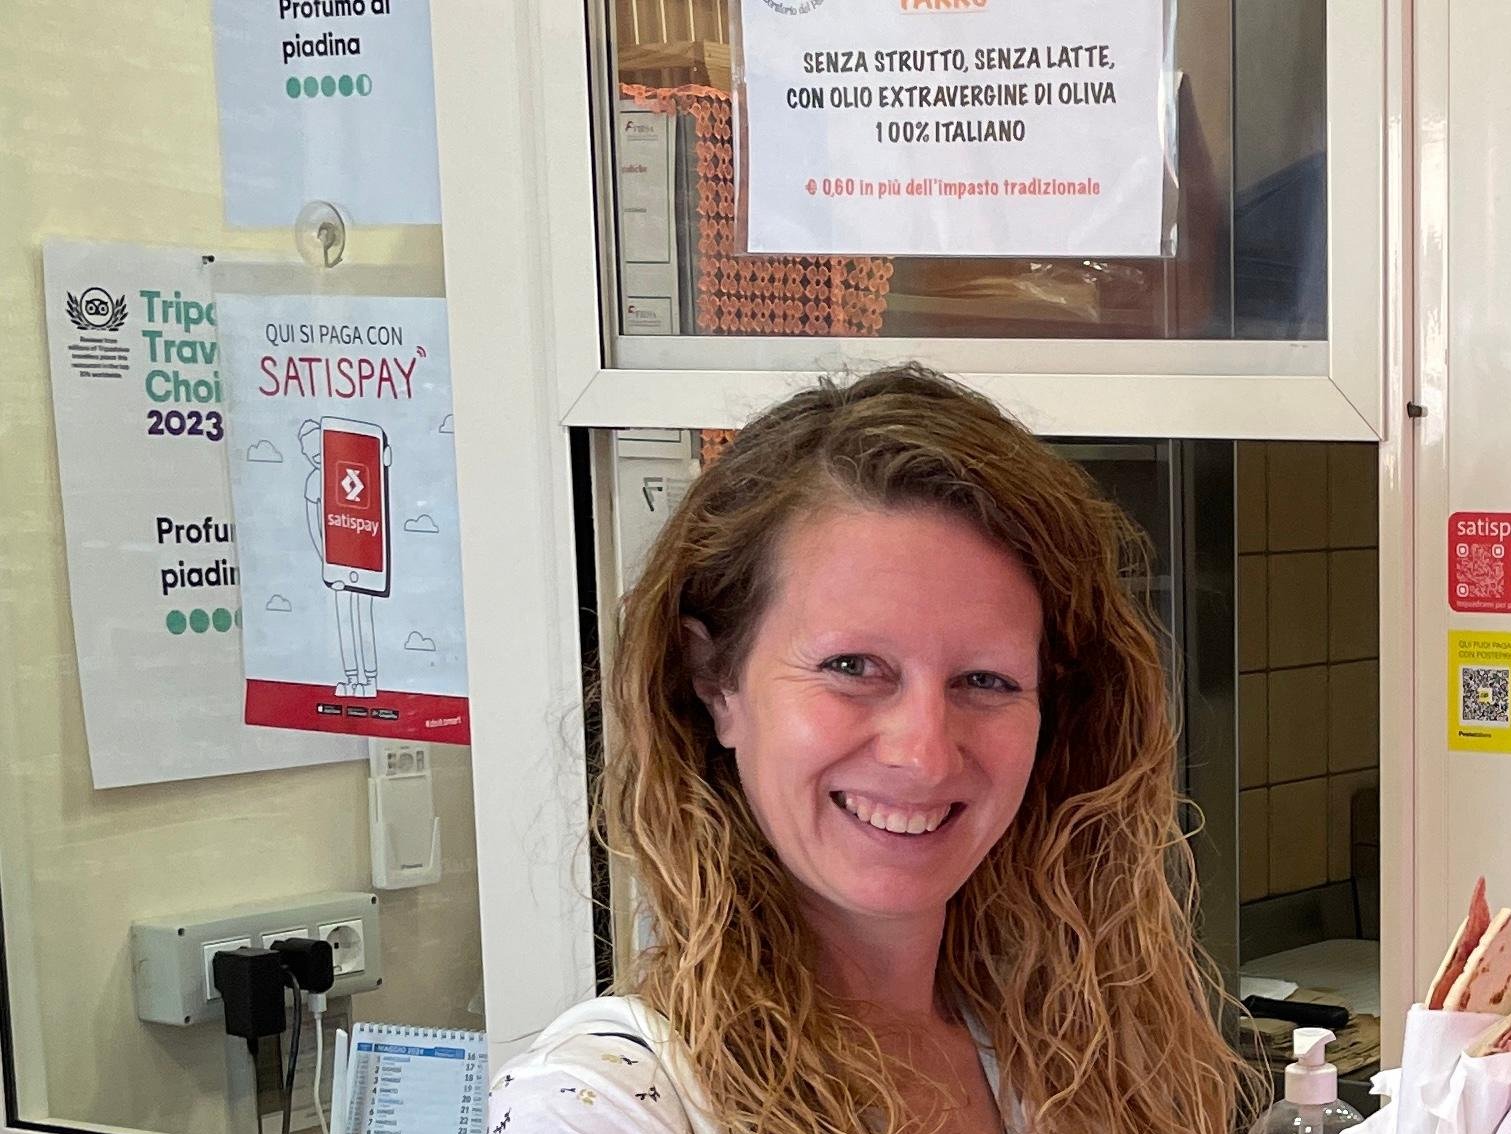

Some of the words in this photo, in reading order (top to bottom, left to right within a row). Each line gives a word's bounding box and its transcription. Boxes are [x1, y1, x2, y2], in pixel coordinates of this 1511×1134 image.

[280, 0, 365, 19] Profumo
[282, 31, 361, 64] piadina
[803, 51, 868, 73] SENZA
[874, 48, 969, 73] STRUTTO,
[974, 47, 1041, 70] SENZA
[1046, 44, 1115, 69] LATTE,
[786, 86, 824, 109] CON
[830, 86, 872, 108] OLIO
[878, 83, 1029, 107] EXTRAVERGINE
[1034, 82, 1052, 105] DI
[1058, 81, 1117, 105] OLIVA
[875, 121, 930, 143] 100%
[935, 119, 1026, 143] ITALIANO
[805, 178, 818, 195] €
[822, 178, 855, 197] 0,60
[860, 180, 874, 195] in
[878, 178, 901, 199] più
[905, 178, 999, 199] dell'impasto
[1003, 177, 1101, 196] tradizionale
[265, 323, 295, 347] QUI
[300, 324, 315, 344] SI
[319, 325, 364, 345] PAGA
[367, 326, 403, 346] CON
[145, 369, 222, 403] Choi
[259, 355, 417, 400] SATISPAY
[147, 410, 224, 442] 2023
[327, 513, 380, 537] satispay
